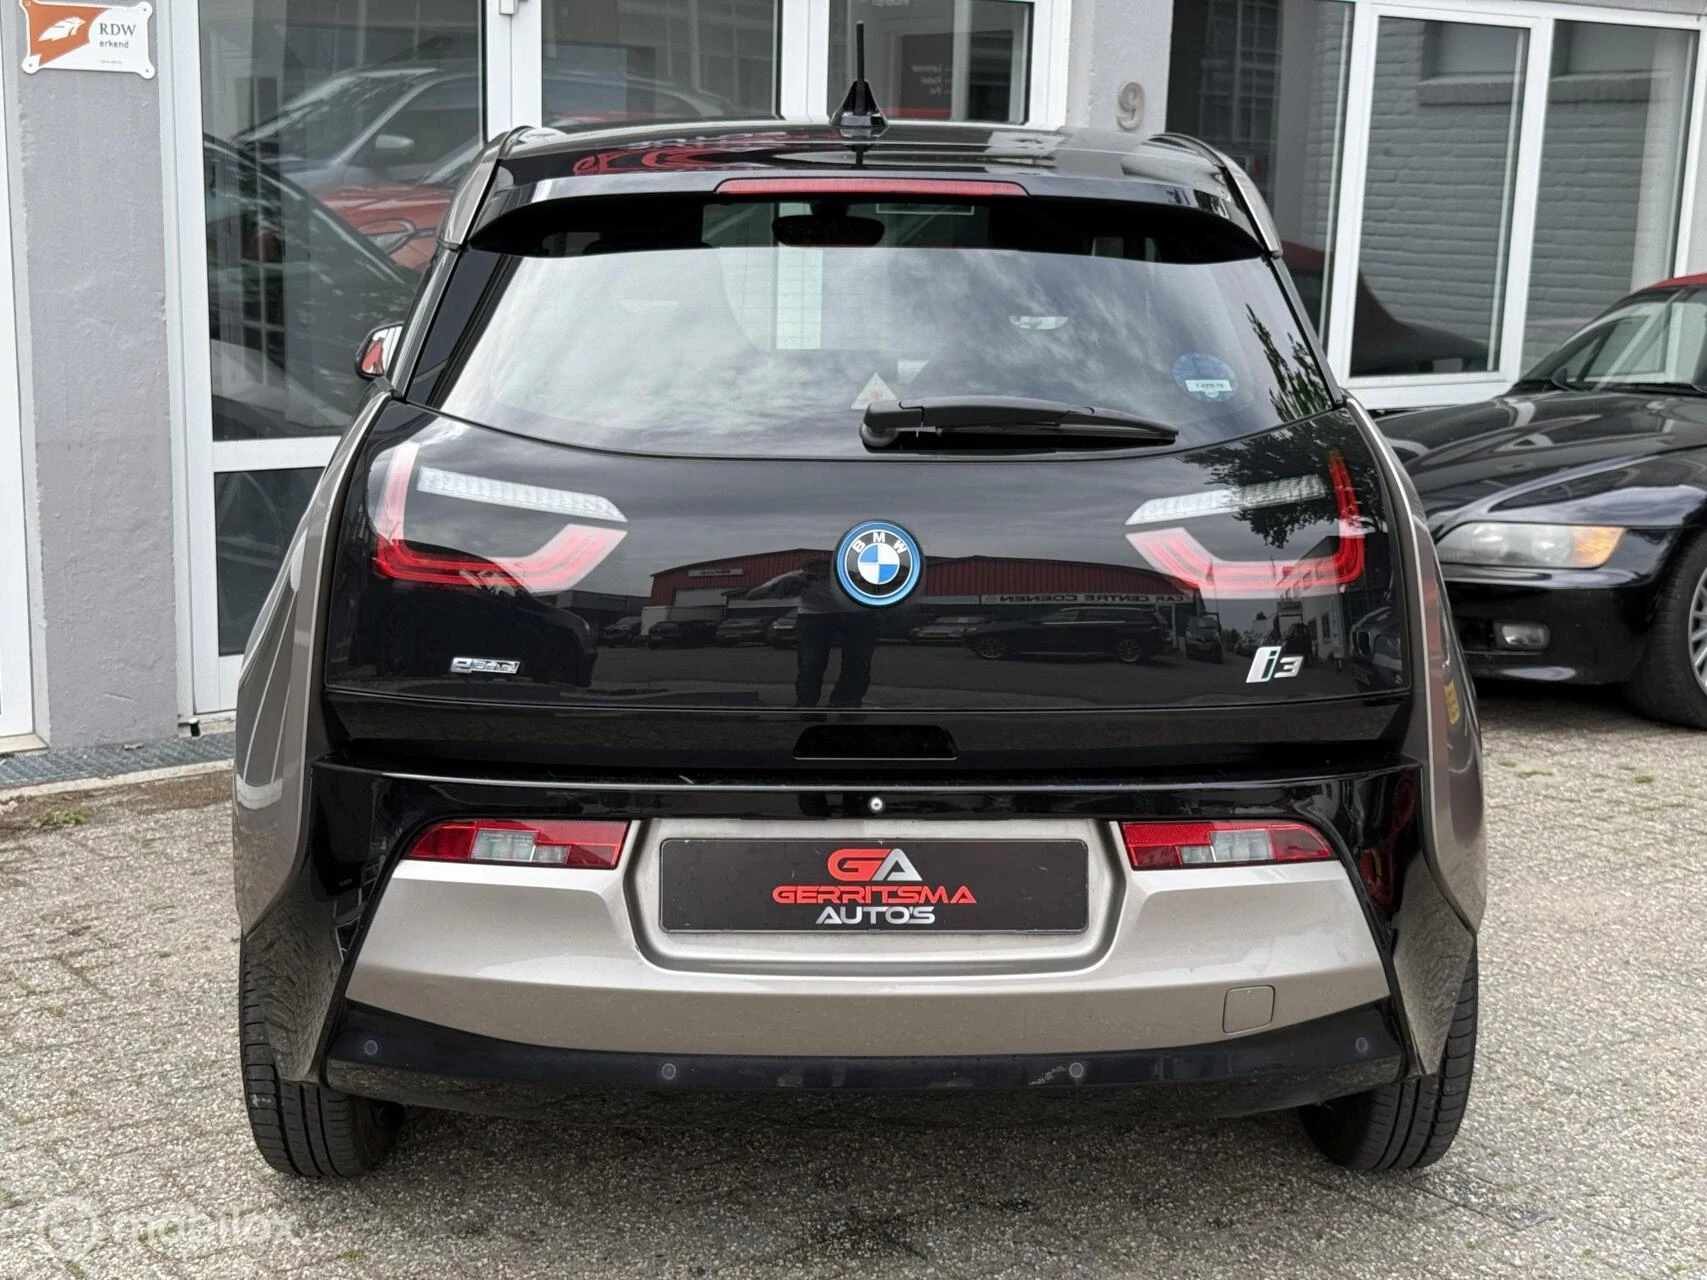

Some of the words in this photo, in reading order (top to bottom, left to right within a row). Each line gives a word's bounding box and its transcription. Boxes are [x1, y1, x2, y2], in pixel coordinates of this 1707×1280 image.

[99, 22, 137, 37] RDW
[99, 39, 130, 49] erkend
[1116, 81, 1145, 132] 9
[851, 531, 908, 554] BMW
[1245, 645, 1304, 684] i3
[827, 847, 923, 882] GA
[772, 885, 977, 904] GERRITSMA
[815, 905, 936, 925] AUTO'S
